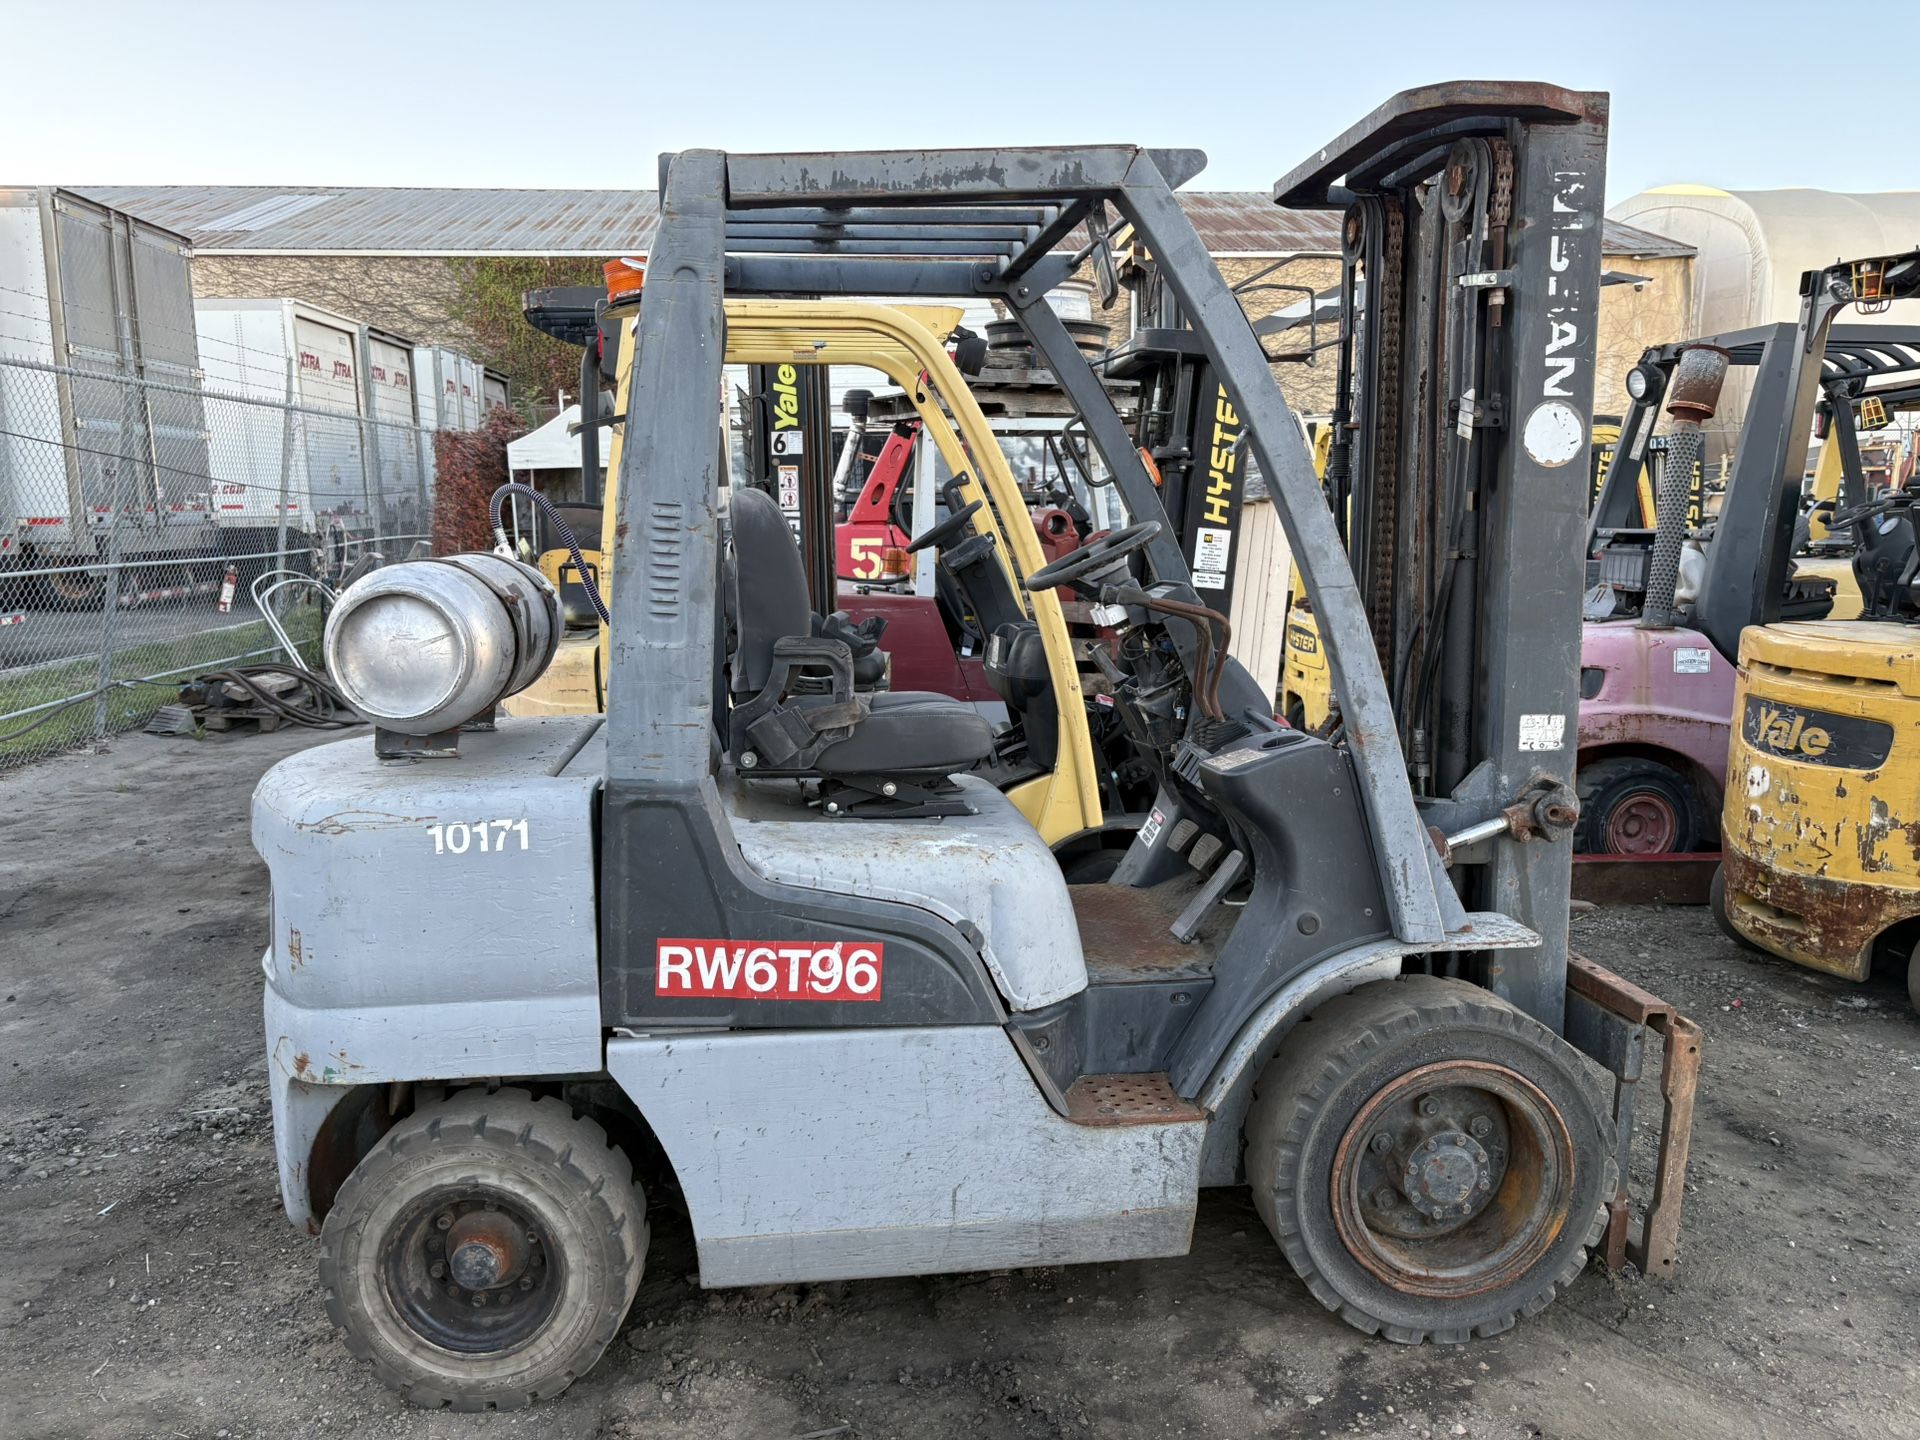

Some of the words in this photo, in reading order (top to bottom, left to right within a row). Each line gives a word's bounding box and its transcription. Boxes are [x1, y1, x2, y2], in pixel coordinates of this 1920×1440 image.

[300, 351, 320, 371] XTRA
[332, 361, 352, 379] XTRA
[371, 366, 386, 381] XTRA
[393, 371, 408, 387] XTRA
[773, 364, 798, 430] Yale
[773, 433, 786, 453] 6
[1203, 382, 1239, 524] HYSTE
[1594, 451, 1613, 504] STE
[851, 538, 883, 579] 5
[1758, 706, 1830, 756] Yale
[427, 819, 529, 854] 10171
[659, 945, 878, 994] RW6T96
